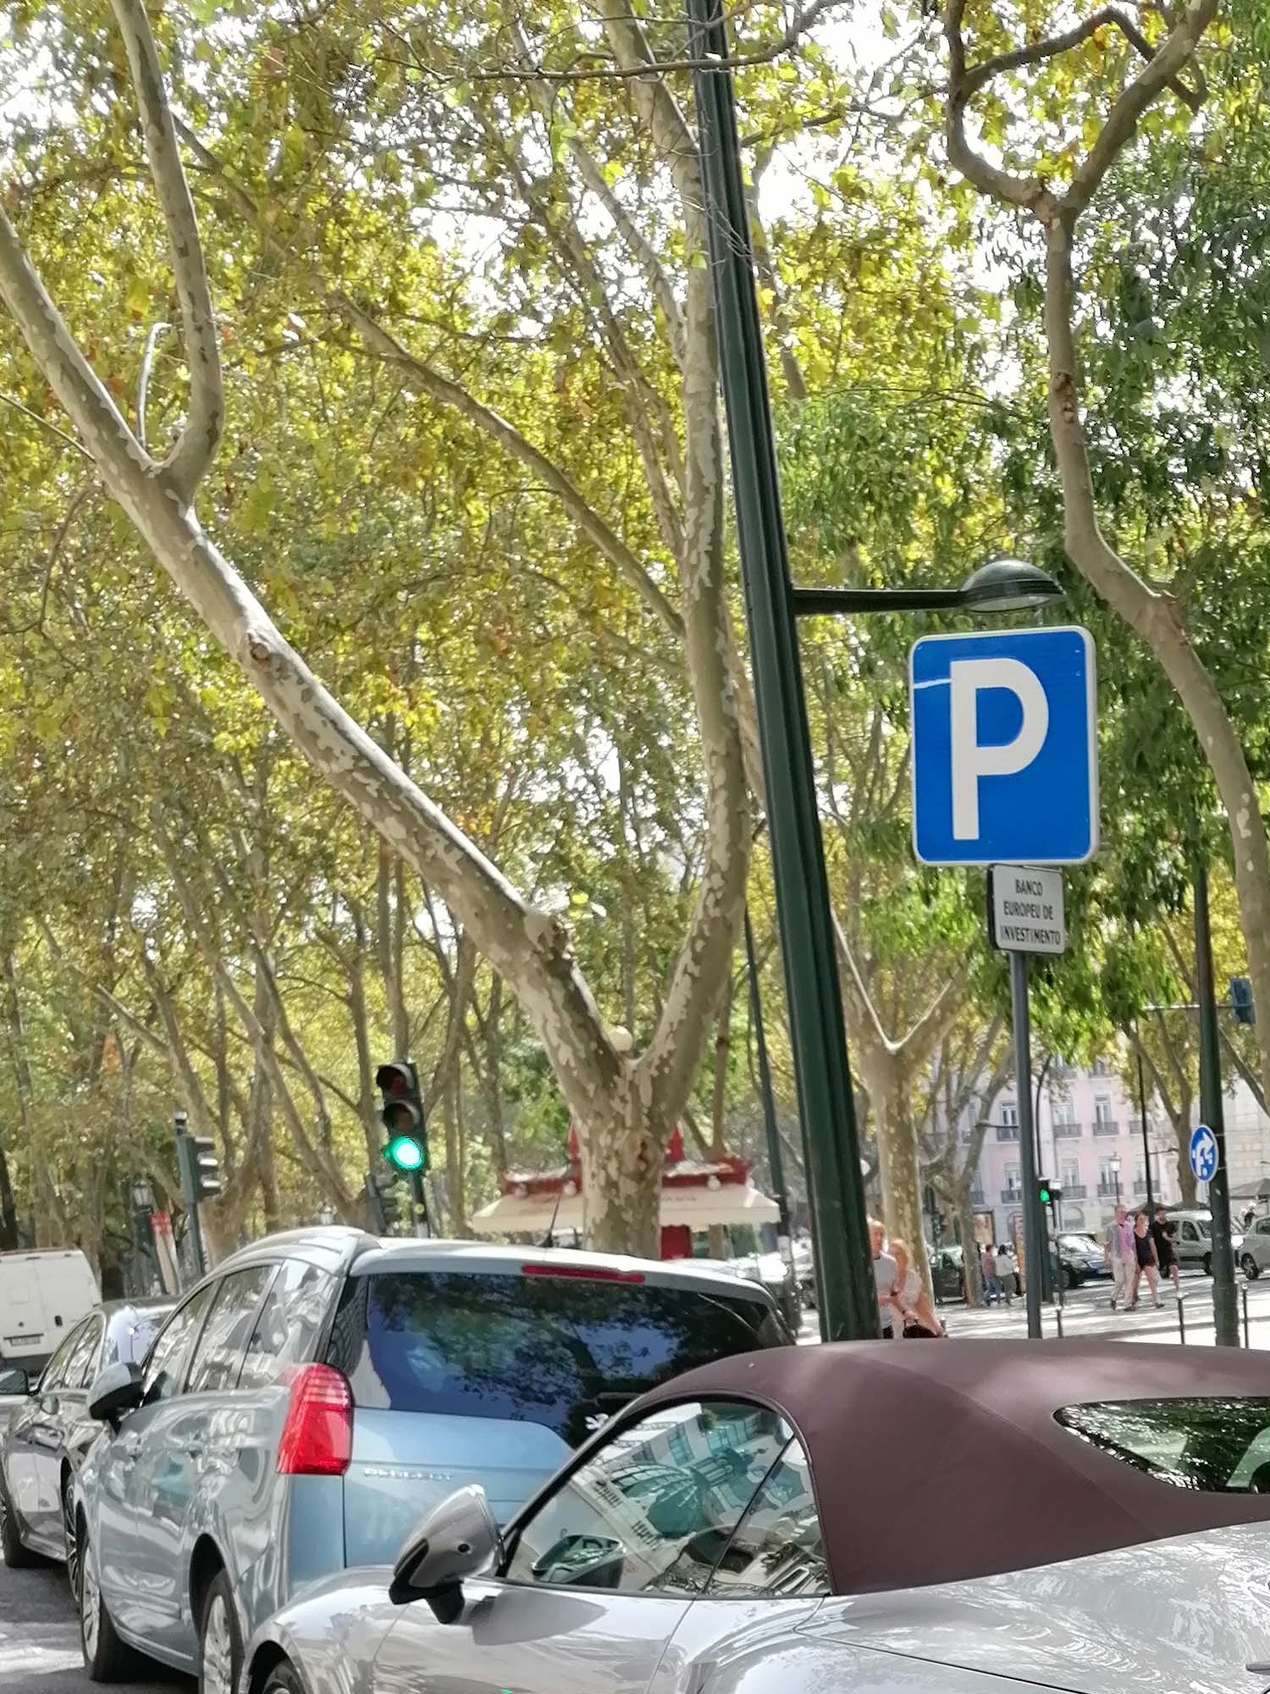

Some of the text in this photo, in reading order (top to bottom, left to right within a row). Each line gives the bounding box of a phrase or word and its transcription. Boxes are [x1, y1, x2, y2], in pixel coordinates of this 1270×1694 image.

[950, 657, 1049, 840] P
[1015, 879, 1043, 897] BANCO
[1004, 901, 1054, 920] EUROPEU DE
[1001, 925, 1061, 945] INVESTIMENTO
